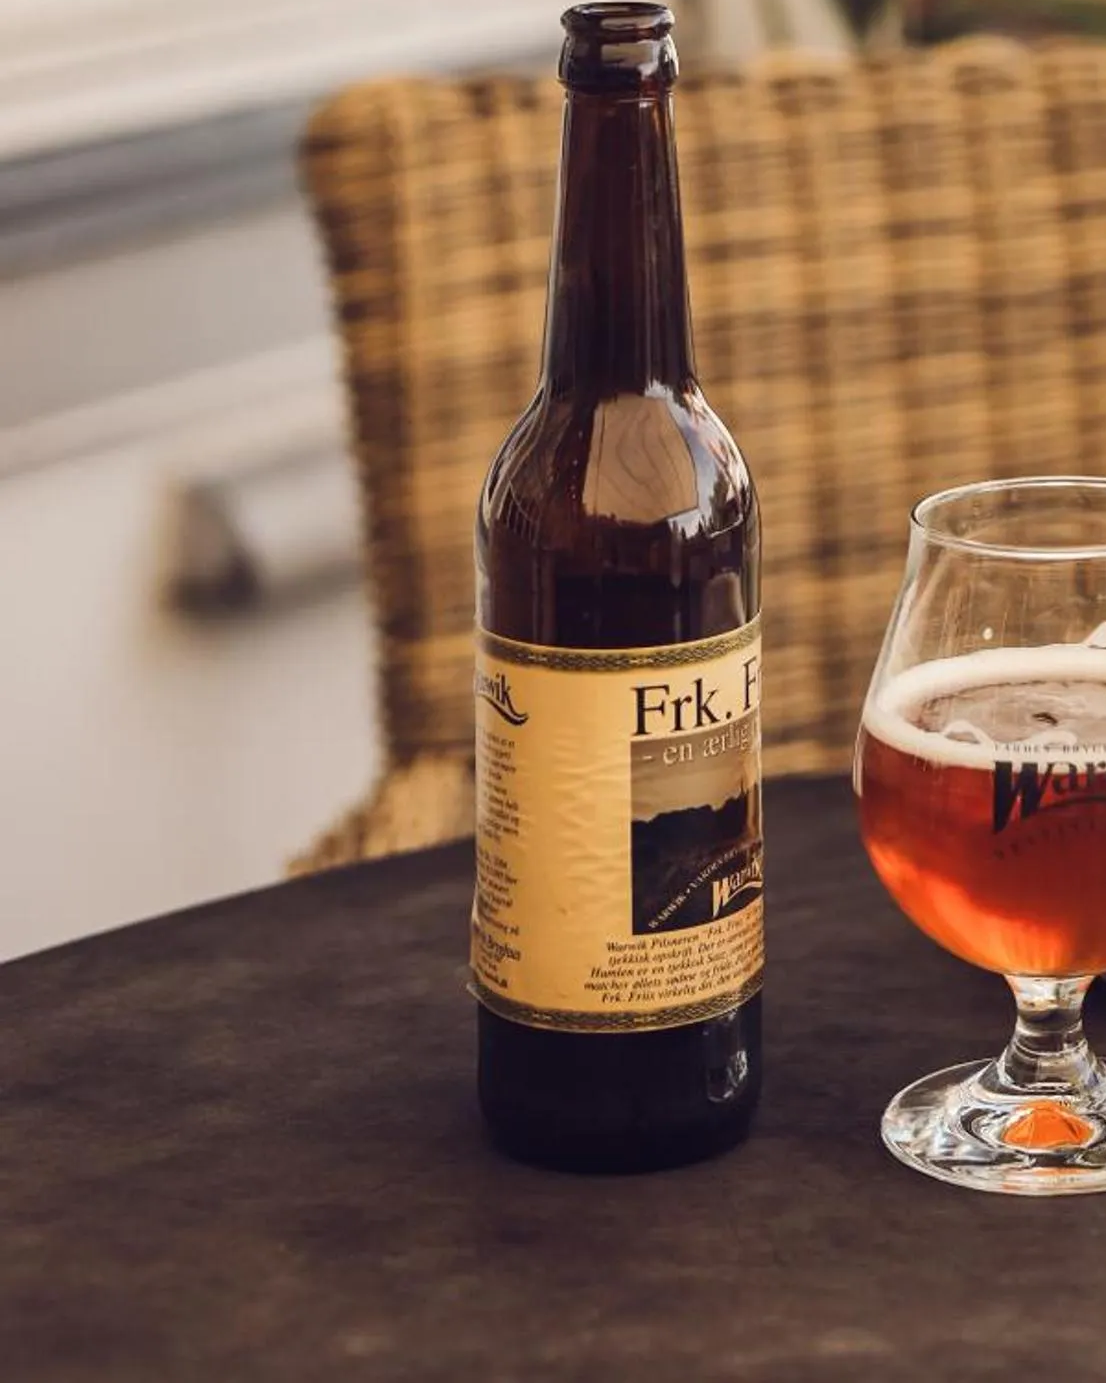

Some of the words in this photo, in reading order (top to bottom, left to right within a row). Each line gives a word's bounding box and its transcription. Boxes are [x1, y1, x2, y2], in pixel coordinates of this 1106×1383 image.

[630, 677, 733, 736] Frk.
[743, 656, 760, 711] F
[663, 742, 693, 765] en
[591, 967, 635, 979] Humlen
